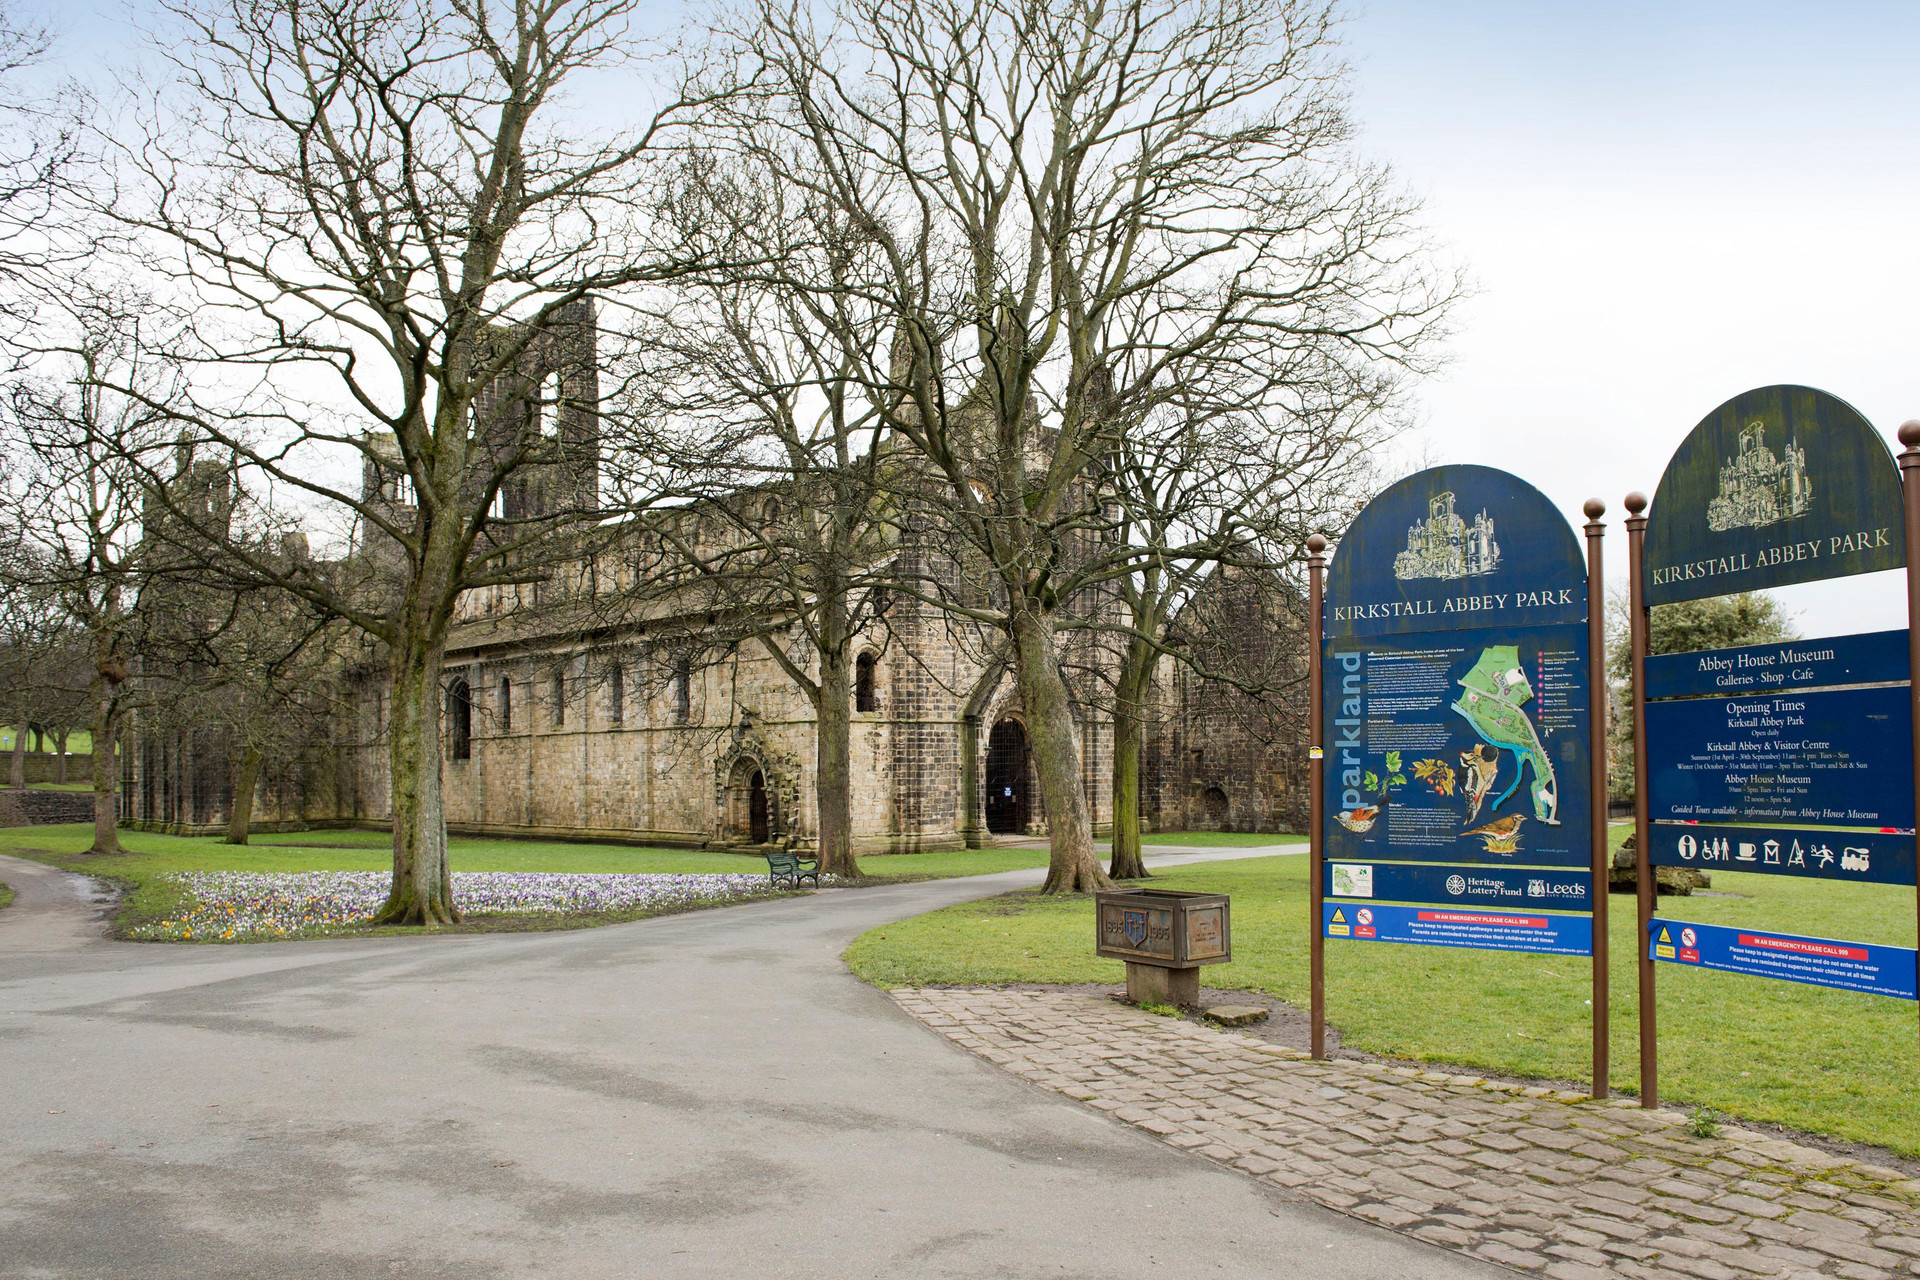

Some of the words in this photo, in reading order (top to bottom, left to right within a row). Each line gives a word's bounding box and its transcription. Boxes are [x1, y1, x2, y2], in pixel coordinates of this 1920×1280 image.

[1653, 554, 1750, 585] KIRKSTALL
[1756, 541, 1822, 567] ABBEY
[1832, 528, 1890, 554] PARK
[1335, 600, 1437, 621] KIRKSTALL
[1443, 594, 1508, 612] ABBEY
[1517, 589, 1573, 607] PARK
[1698, 656, 1734, 672] Abbey
[1738, 654, 1775, 668] House
[1780, 650, 1834, 664] Museum
[1716, 675, 1754, 686] Galleries
[1761, 672, 1784, 684] Shop
[1792, 668, 1814, 680] Cafe
[1727, 703, 1770, 717] Opening
[1773, 700, 1805, 712] Times
[1728, 717, 1758, 728] Kirkstall
[1760, 717, 1785, 728] Abbey
[1787, 716, 1804, 725] Park
[1335, 652, 1368, 809] parkland
[1752, 730, 1766, 738] Open
[1708, 742, 1736, 751] Kirkstall
[1739, 741, 1762, 752] Abbey
[1764, 742, 1771, 750] &
[1774, 741, 1800, 750] Visitor
[1802, 740, 1830, 750] Centre
[1725, 774, 1748, 786] Abbey
[1751, 774, 1774, 784] House
[1777, 774, 1811, 784] Museum
[1672, 805, 1693, 813] Guided
[1695, 806, 1710, 814] Tours
[1712, 806, 1738, 815] available
[1744, 807, 1780, 818] information
[1781, 807, 1797, 819] from
[1799, 808, 1821, 820] Abbey
[1823, 809, 1845, 818] House
[1847, 810, 1878, 819] Museum
[1468, 878, 1505, 889] Heritage
[1546, 883, 1585, 895] Leeds
[1468, 886, 1499, 897] Lottery
[1500, 888, 1522, 896] Fund
[1768, 940, 1800, 949] EMERGENCY
[1801, 944, 1822, 952] PLEASE
[1762, 951, 1788, 960] designated
